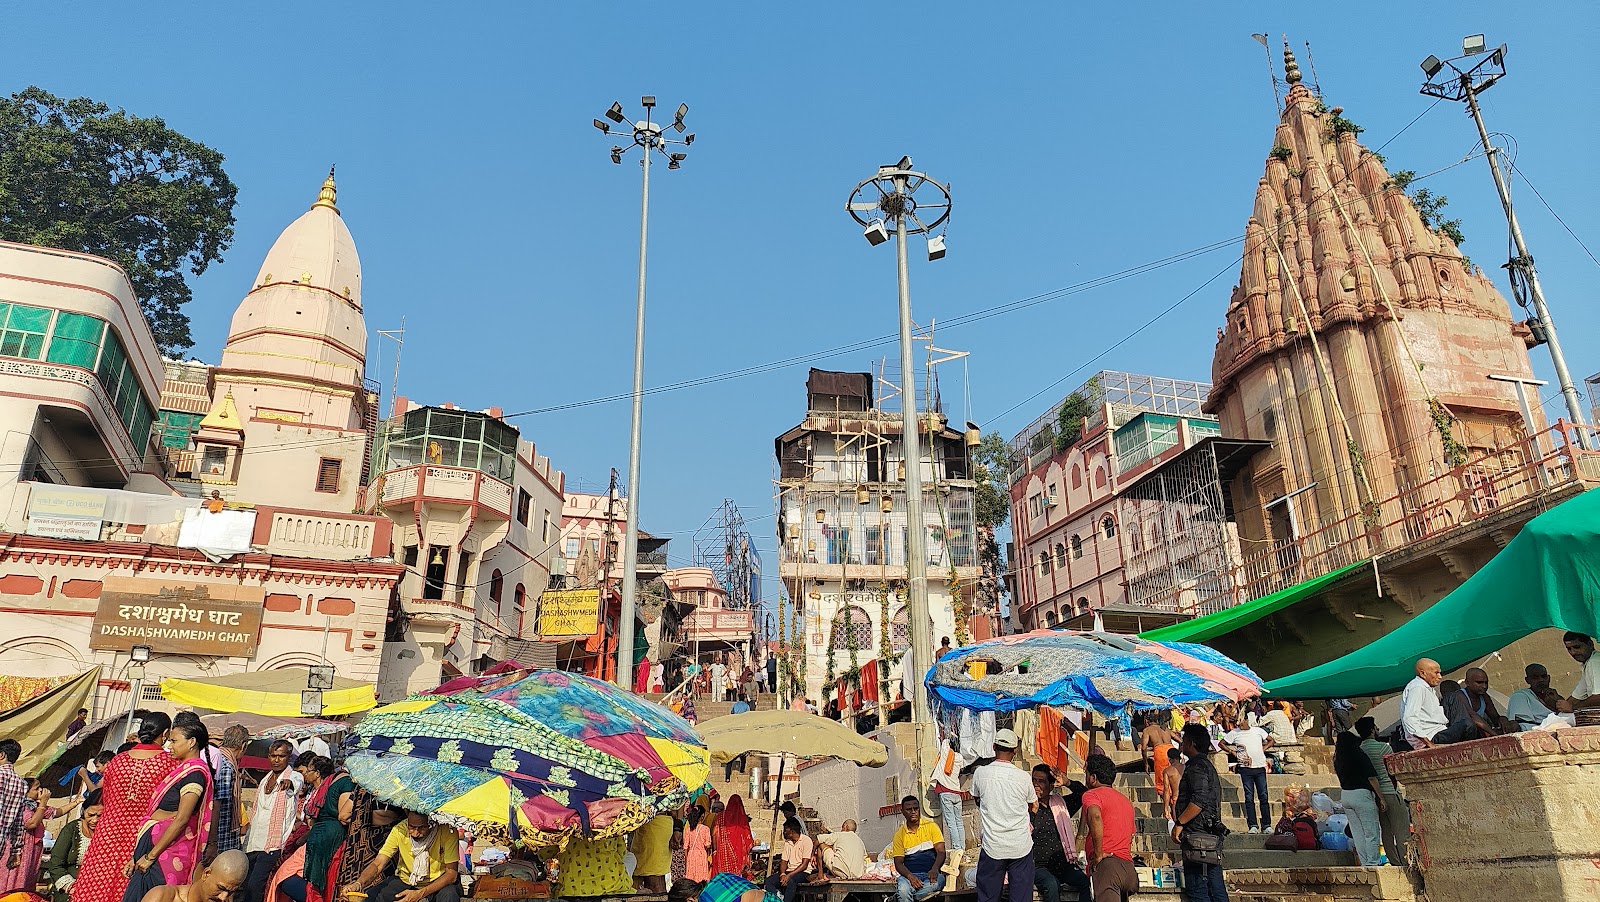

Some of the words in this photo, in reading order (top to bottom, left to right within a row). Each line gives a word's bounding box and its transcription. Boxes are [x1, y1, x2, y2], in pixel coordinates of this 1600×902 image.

[118, 603, 204, 625] दशाश्वमेध
[208, 609, 243, 626] घाट
[554, 619, 577, 627] GHAT
[100, 624, 216, 641] DASHASHVAMEDH
[217, 631, 251, 643] GHAT
